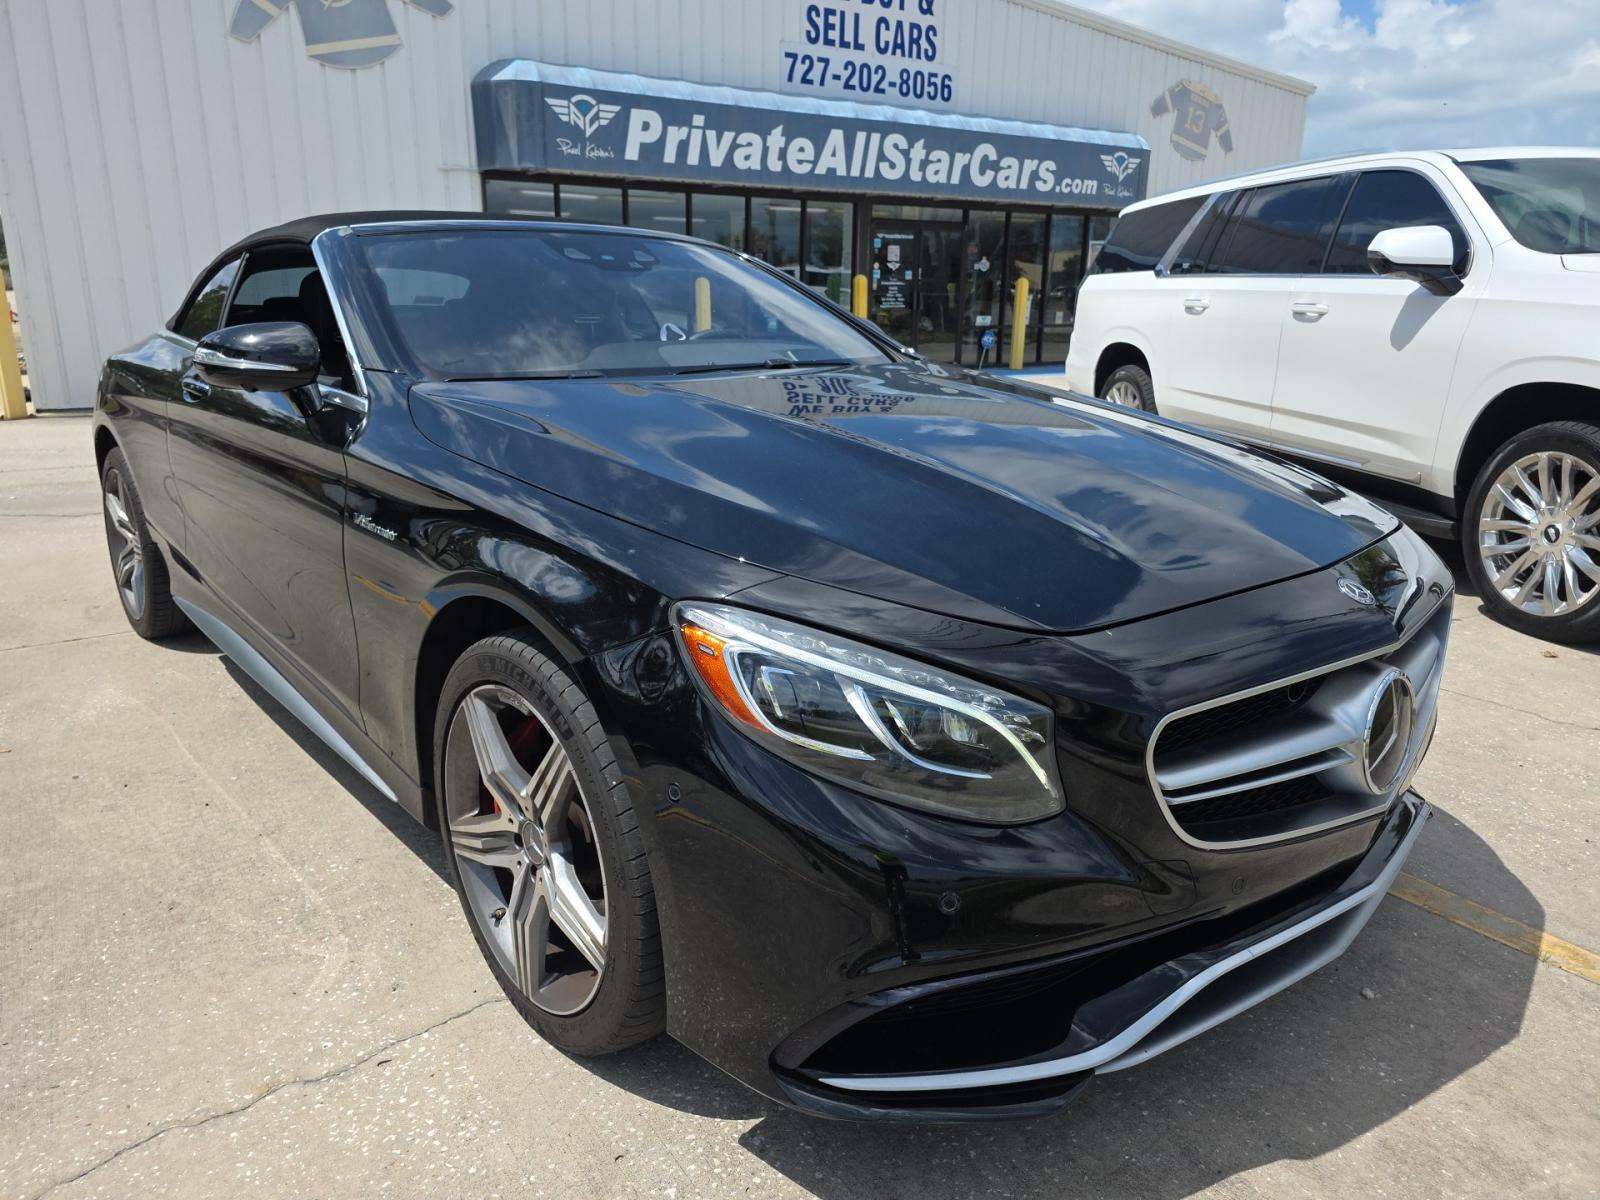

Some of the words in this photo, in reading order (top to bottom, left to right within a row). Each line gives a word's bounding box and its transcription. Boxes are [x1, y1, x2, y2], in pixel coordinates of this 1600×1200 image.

[805, 4, 865, 51] SELL
[874, 16, 938, 62] CARS
[784, 52, 953, 103] 727-202-8056
[623, 107, 1098, 196] PrivateAllStarCars.com
